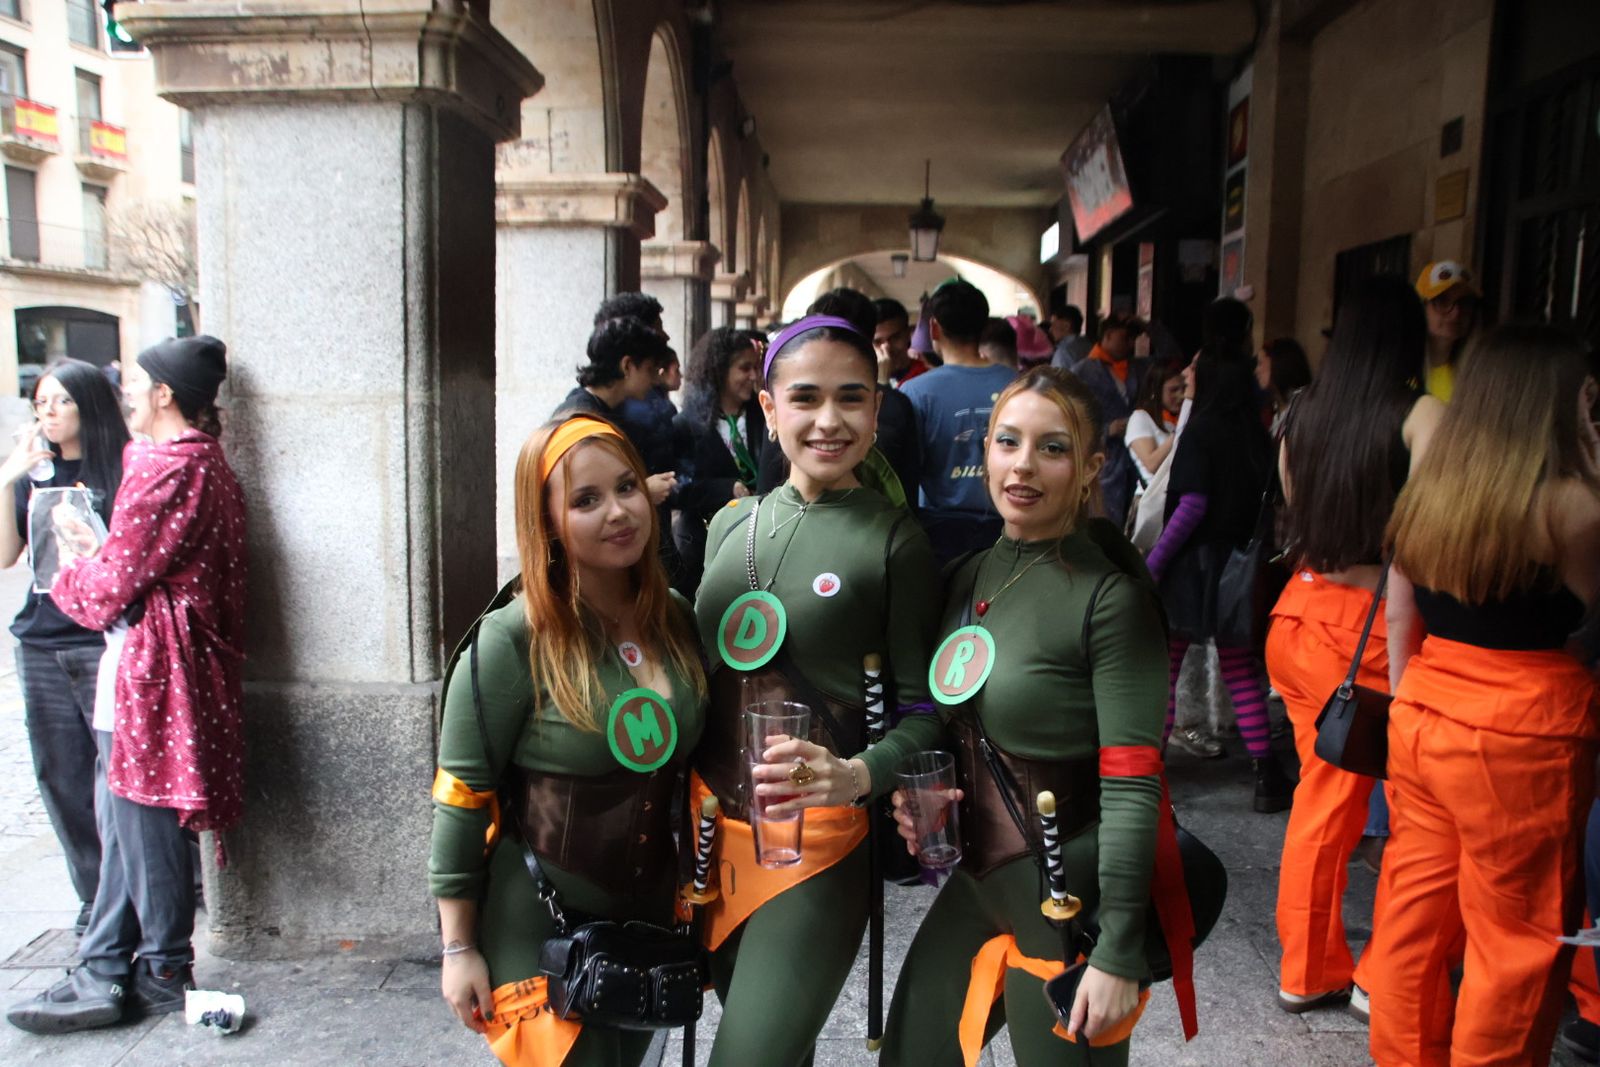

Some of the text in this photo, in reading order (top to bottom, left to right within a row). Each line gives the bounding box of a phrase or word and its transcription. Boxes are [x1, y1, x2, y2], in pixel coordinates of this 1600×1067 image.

[733, 606, 768, 650] D
[943, 640, 976, 689] R
[623, 702, 664, 757] M
